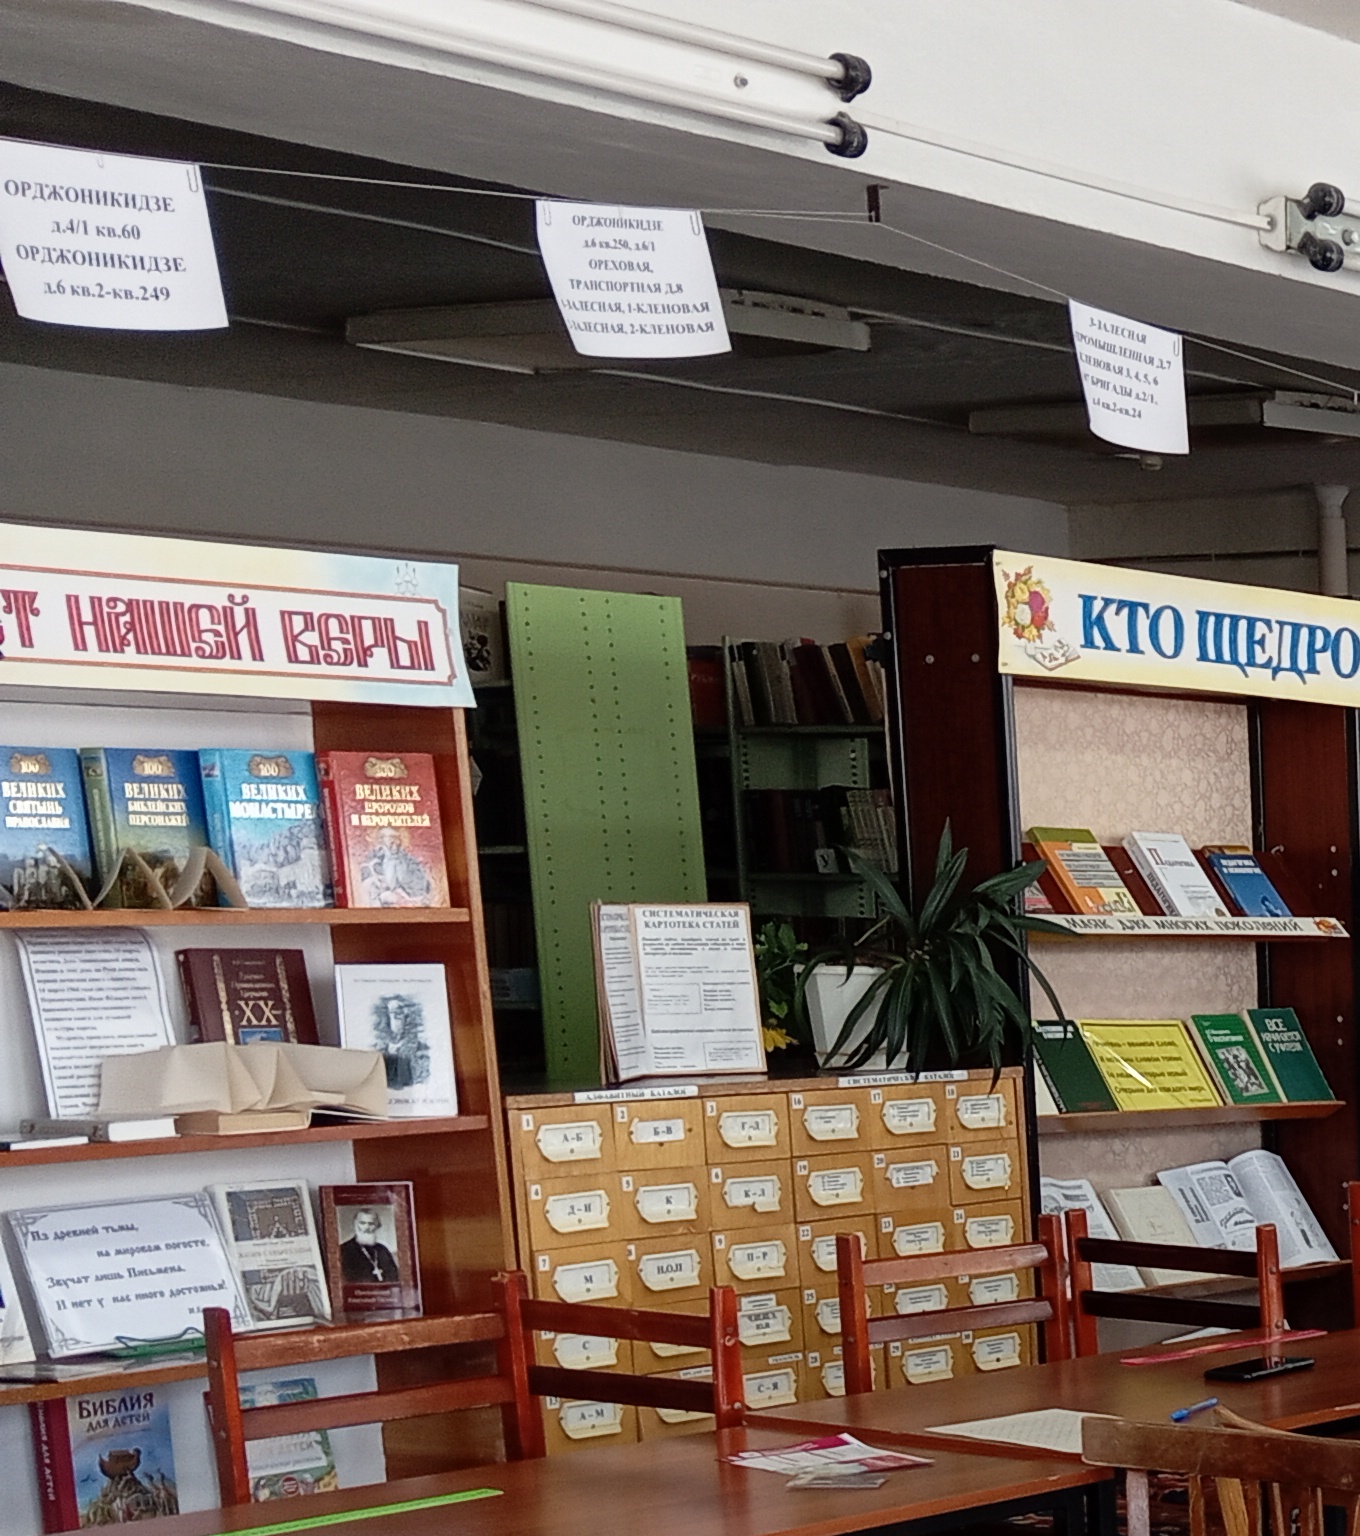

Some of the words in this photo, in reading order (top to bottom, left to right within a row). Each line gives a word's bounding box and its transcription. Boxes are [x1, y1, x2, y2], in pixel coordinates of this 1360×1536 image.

[4, 179, 176, 213] ОРДЖОНИКИДЗЕ
[51, 218, 89, 236] д.4/1
[95, 224, 141, 240] кв.60
[572, 214, 664, 232] ОРДЖОНИКИДЗЕ
[16, 243, 187, 273] ОРДЖОНИКИДЗЕ
[588, 258, 654, 274] ОРЕХОВАЯ,
[43, 279, 66, 295] д.6
[70, 282, 171, 301] кв.2-кв.249
[569, 278, 662, 295] ТРАНСПОРТНАЯ
[627, 302, 711, 316] 1-КЛЕНОВАЯ
[629, 321, 715, 336] 2-КЛЕНОВАЯ
[65, 593, 266, 662] НАШЕЙ
[280, 609, 436, 671] ВЕРЫ
[1077, 593, 1185, 660] КТО
[20, 761, 40, 774] 100
[142, 762, 163, 775] 100
[1, 781, 67, 799] ВЕЛИКИХ
[124, 782, 187, 800] ВЕЛИКИХ
[241, 783, 307, 801] ВЕЛИКИХ
[355, 783, 421, 802] ВЕЛИКИХ
[642, 909, 739, 919] СИСТЕМАТИЧЕСКАЯ
[644, 920, 700, 929] КАРТОТЕКА
[702, 919, 740, 929] СТАТЕЙ
[1264, 1018, 1288, 1032] ВСЕ
[665, 1195, 674, 1206] К
[53, 1225, 99, 1241] древней
[46, 1275, 90, 1289] Звучат
[583, 1274, 594, 1286] М
[71, 1299, 93, 1310] нет
[582, 1340, 590, 1351] С
[78, 1392, 154, 1419] БИБЛИЯ
